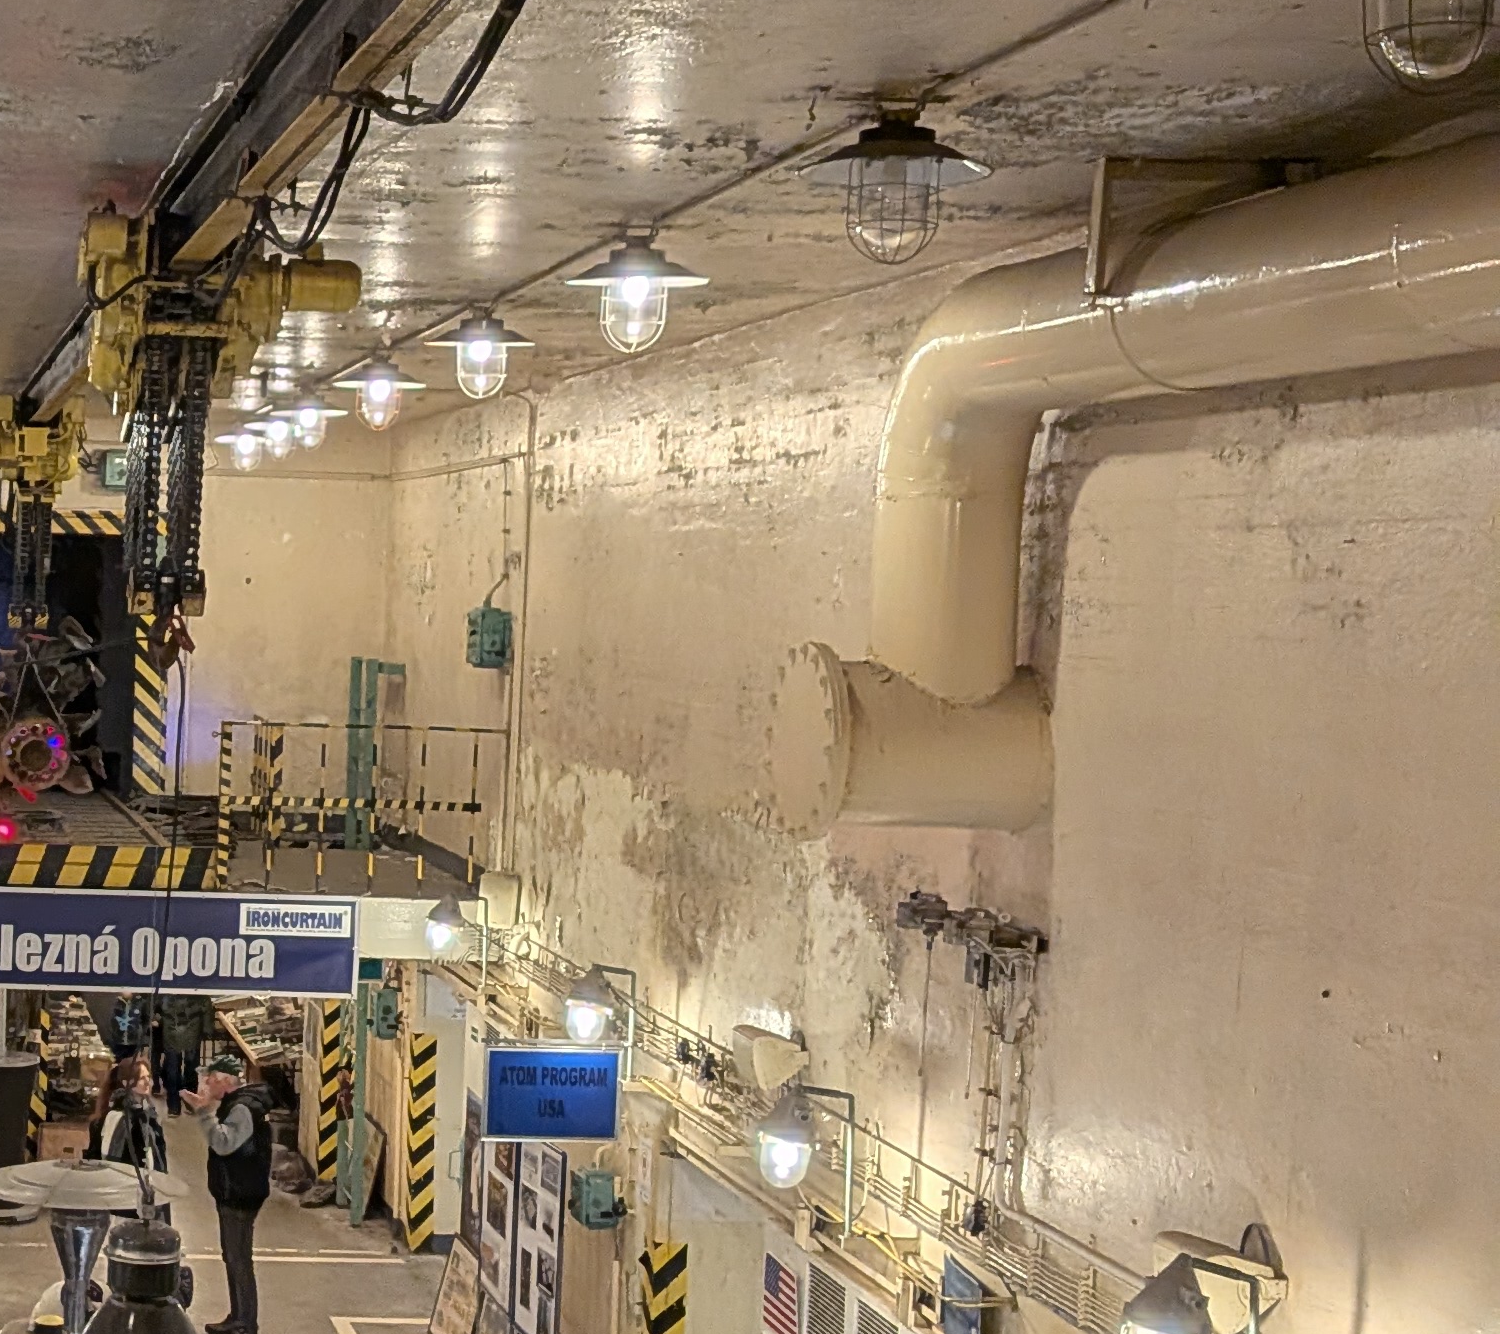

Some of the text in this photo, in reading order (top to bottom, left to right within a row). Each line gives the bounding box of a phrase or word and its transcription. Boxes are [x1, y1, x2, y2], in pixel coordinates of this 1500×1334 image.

[131, 926, 275, 981] Opona
[499, 1066, 608, 1087] ATOM PROGRAM
[538, 1099, 565, 1119] USA
